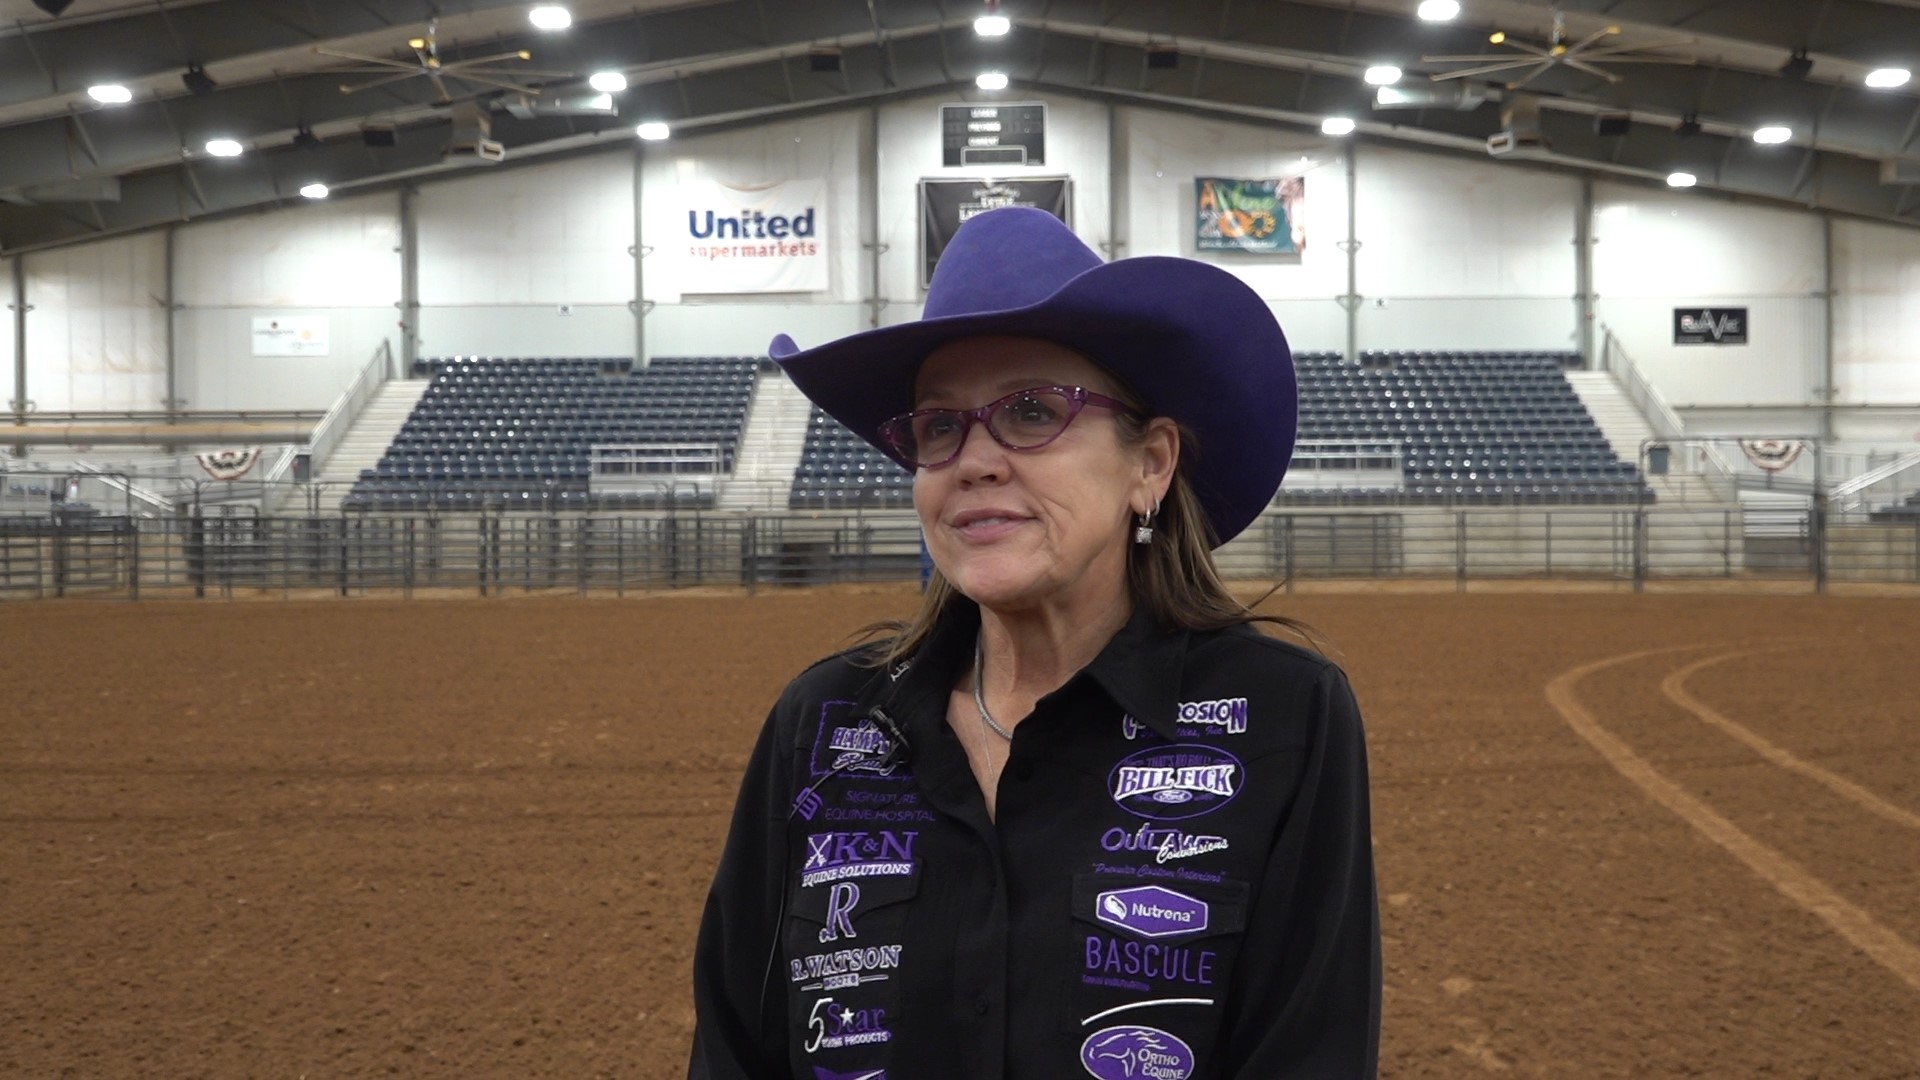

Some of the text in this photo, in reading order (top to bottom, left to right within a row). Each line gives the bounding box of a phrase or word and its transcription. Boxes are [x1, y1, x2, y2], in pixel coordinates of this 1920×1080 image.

[688, 207, 815, 240] United
[689, 242, 818, 261] supermarkets
[1114, 763, 1236, 801] BILL FICK
[824, 807, 937, 823] EQUINE HOSPITAL
[1156, 837, 1230, 865] Conversions
[838, 862, 912, 880] SOLUTIONS
[1085, 935, 1217, 985] BASCULE
[823, 973, 860, 990] BOOTS
[1138, 1048, 1180, 1066] ORTHO
[1141, 1061, 1185, 1079] EQUINE
